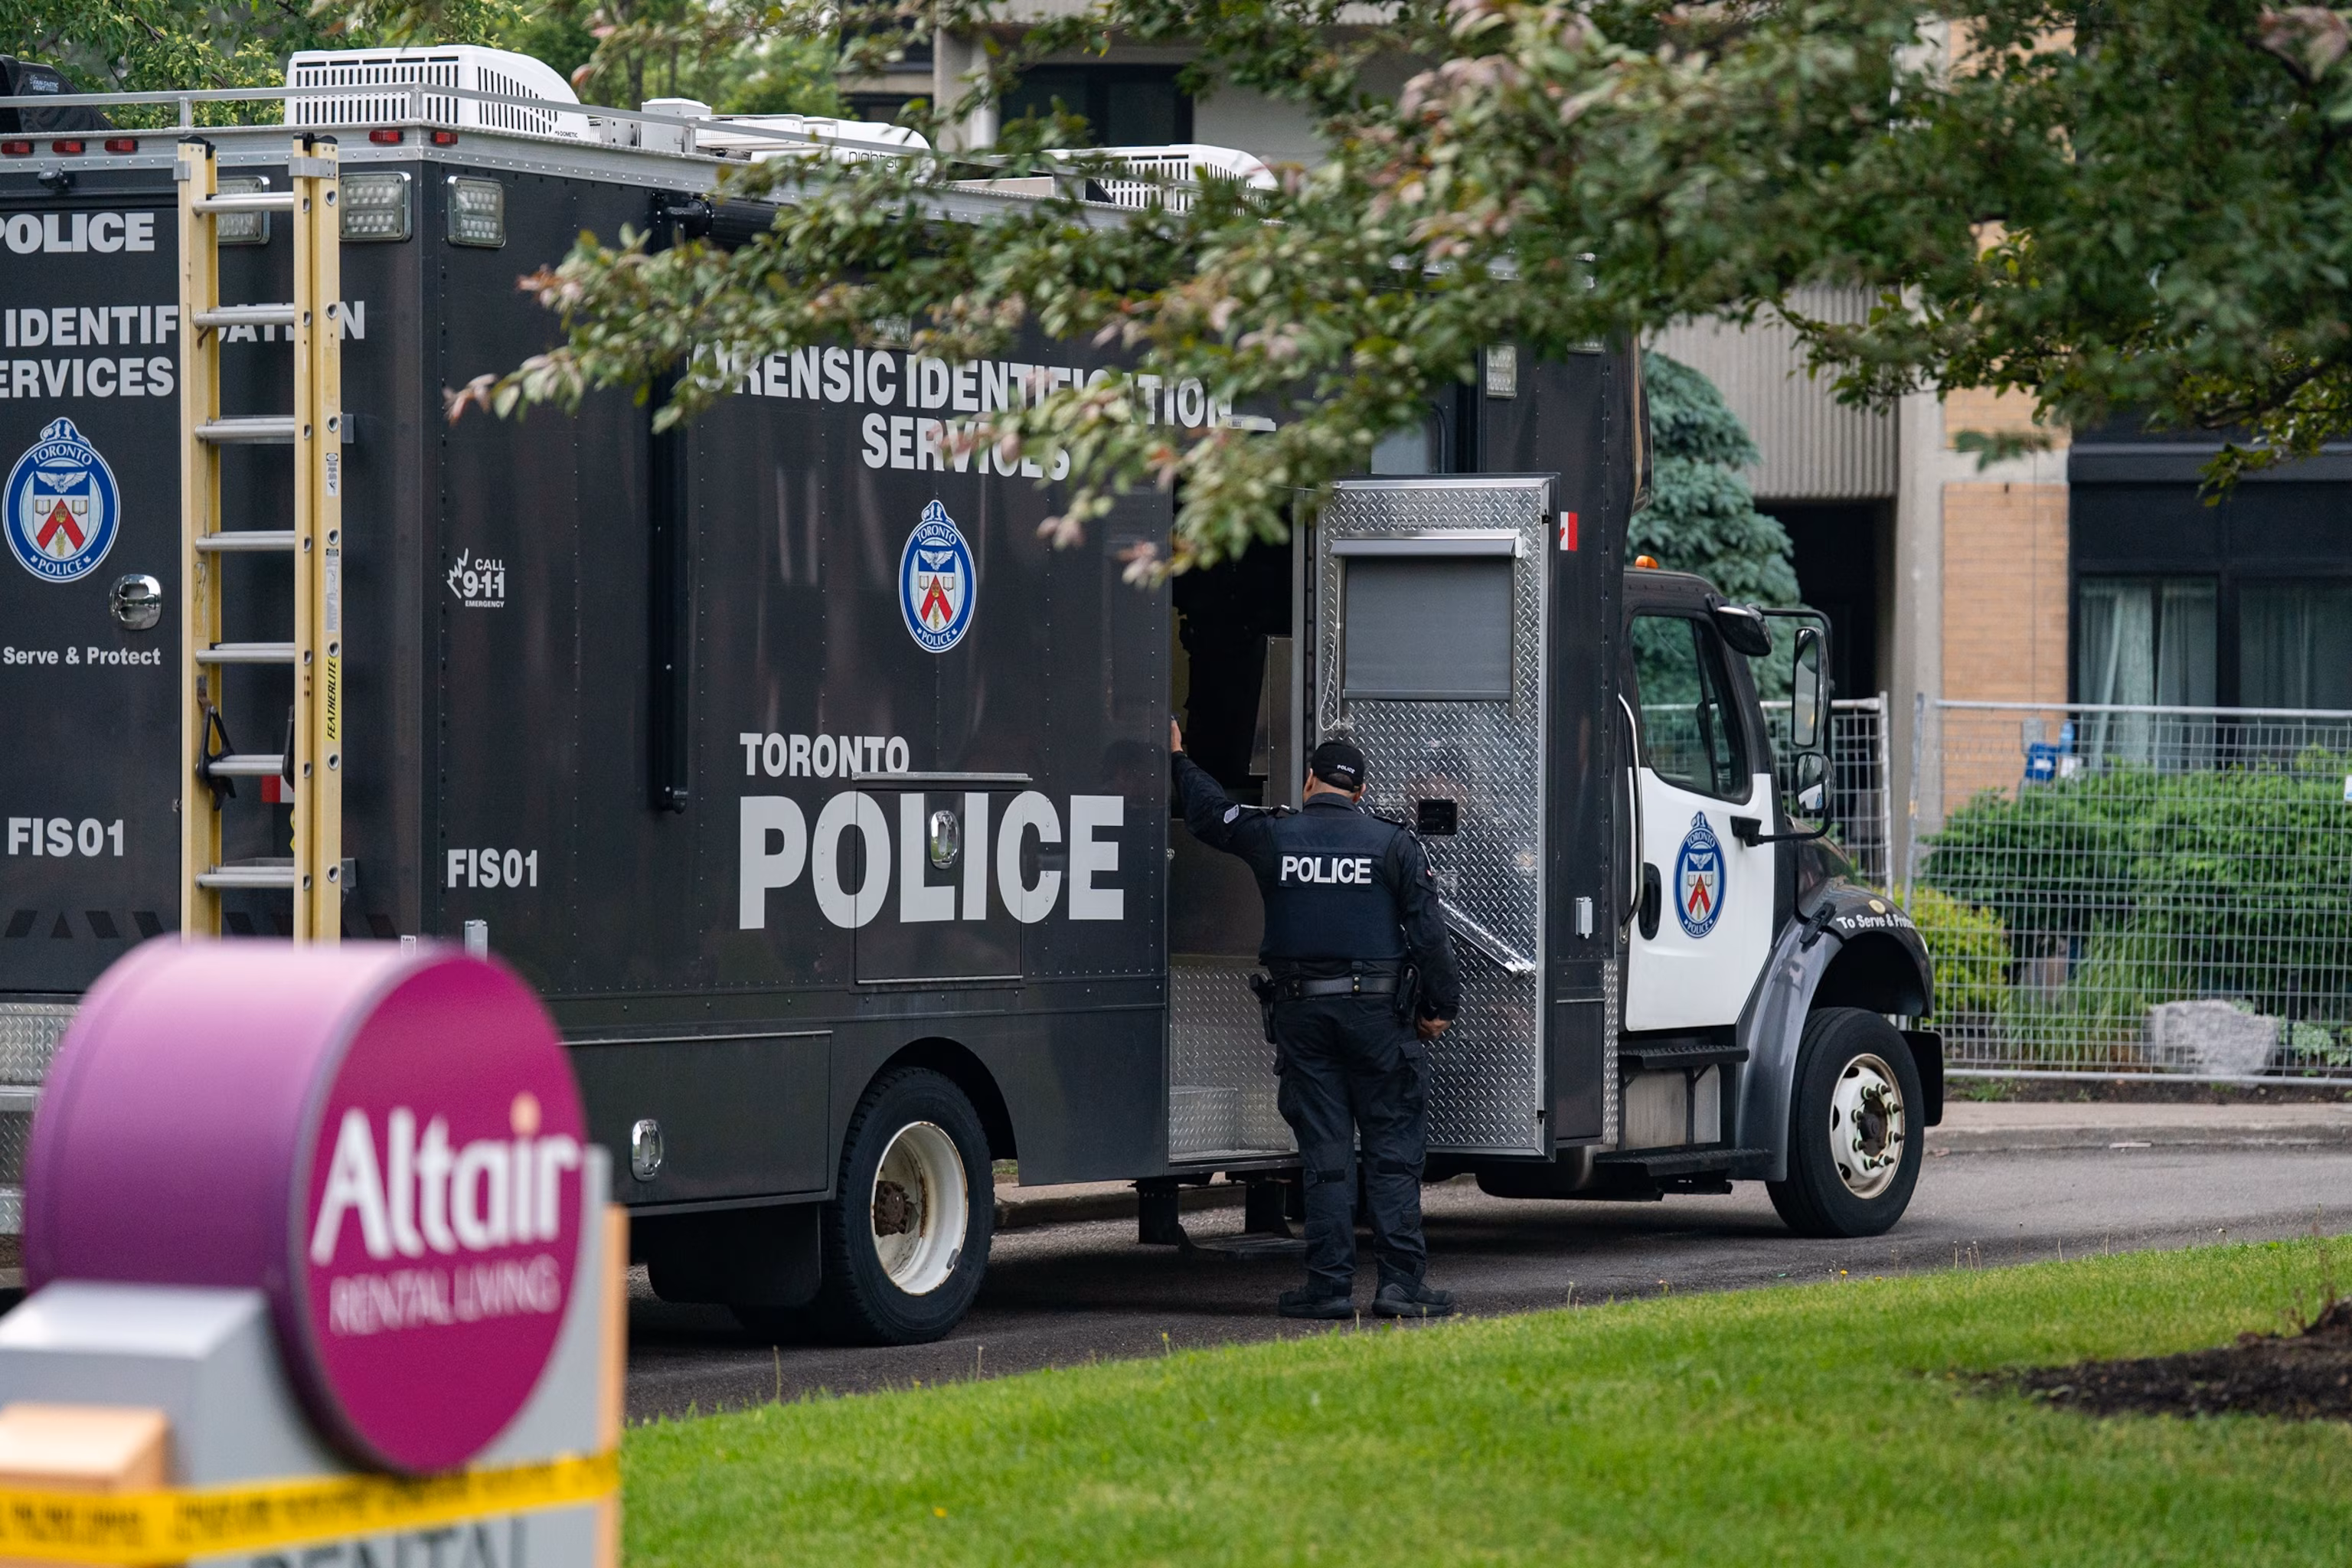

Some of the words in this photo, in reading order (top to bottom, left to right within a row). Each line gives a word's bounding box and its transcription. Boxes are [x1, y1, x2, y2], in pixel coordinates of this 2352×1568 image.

[0, 212, 155, 254] OLICE
[687, 334, 897, 407] ORENSIC
[31, 444, 93, 466] TORONTO
[916, 525, 957, 545] TORONTO
[38, 559, 83, 576] POLICE
[475, 558, 505, 571] CALL
[462, 570, 505, 598] 9-1-1
[465, 599, 505, 608] EMERGENCY
[921, 630, 952, 646] POLICE
[3, 646, 59, 665] Serve
[65, 646, 80, 665] &
[87, 646, 161, 665] Protect
[327, 658, 336, 740] FEATHERLITE
[740, 733, 910, 778] TORONTO
[1337, 764, 1356, 774] POLICE
[8, 817, 123, 858] FIS01
[1687, 831, 1715, 848] TORONTO
[448, 848, 537, 888] FIS01
[739, 790, 1125, 929] POLICE
[1281, 855, 1372, 884] POLICE
[1687, 921, 1709, 935] POLICE
[1836, 916, 1855, 929] To
[1856, 914, 1885, 928] Serve
[1885, 913, 1894, 927] &
[310, 1090, 579, 1266] Altair
[329, 1268, 458, 1337] RENTAL
[453, 1253, 562, 1323] LIVING
